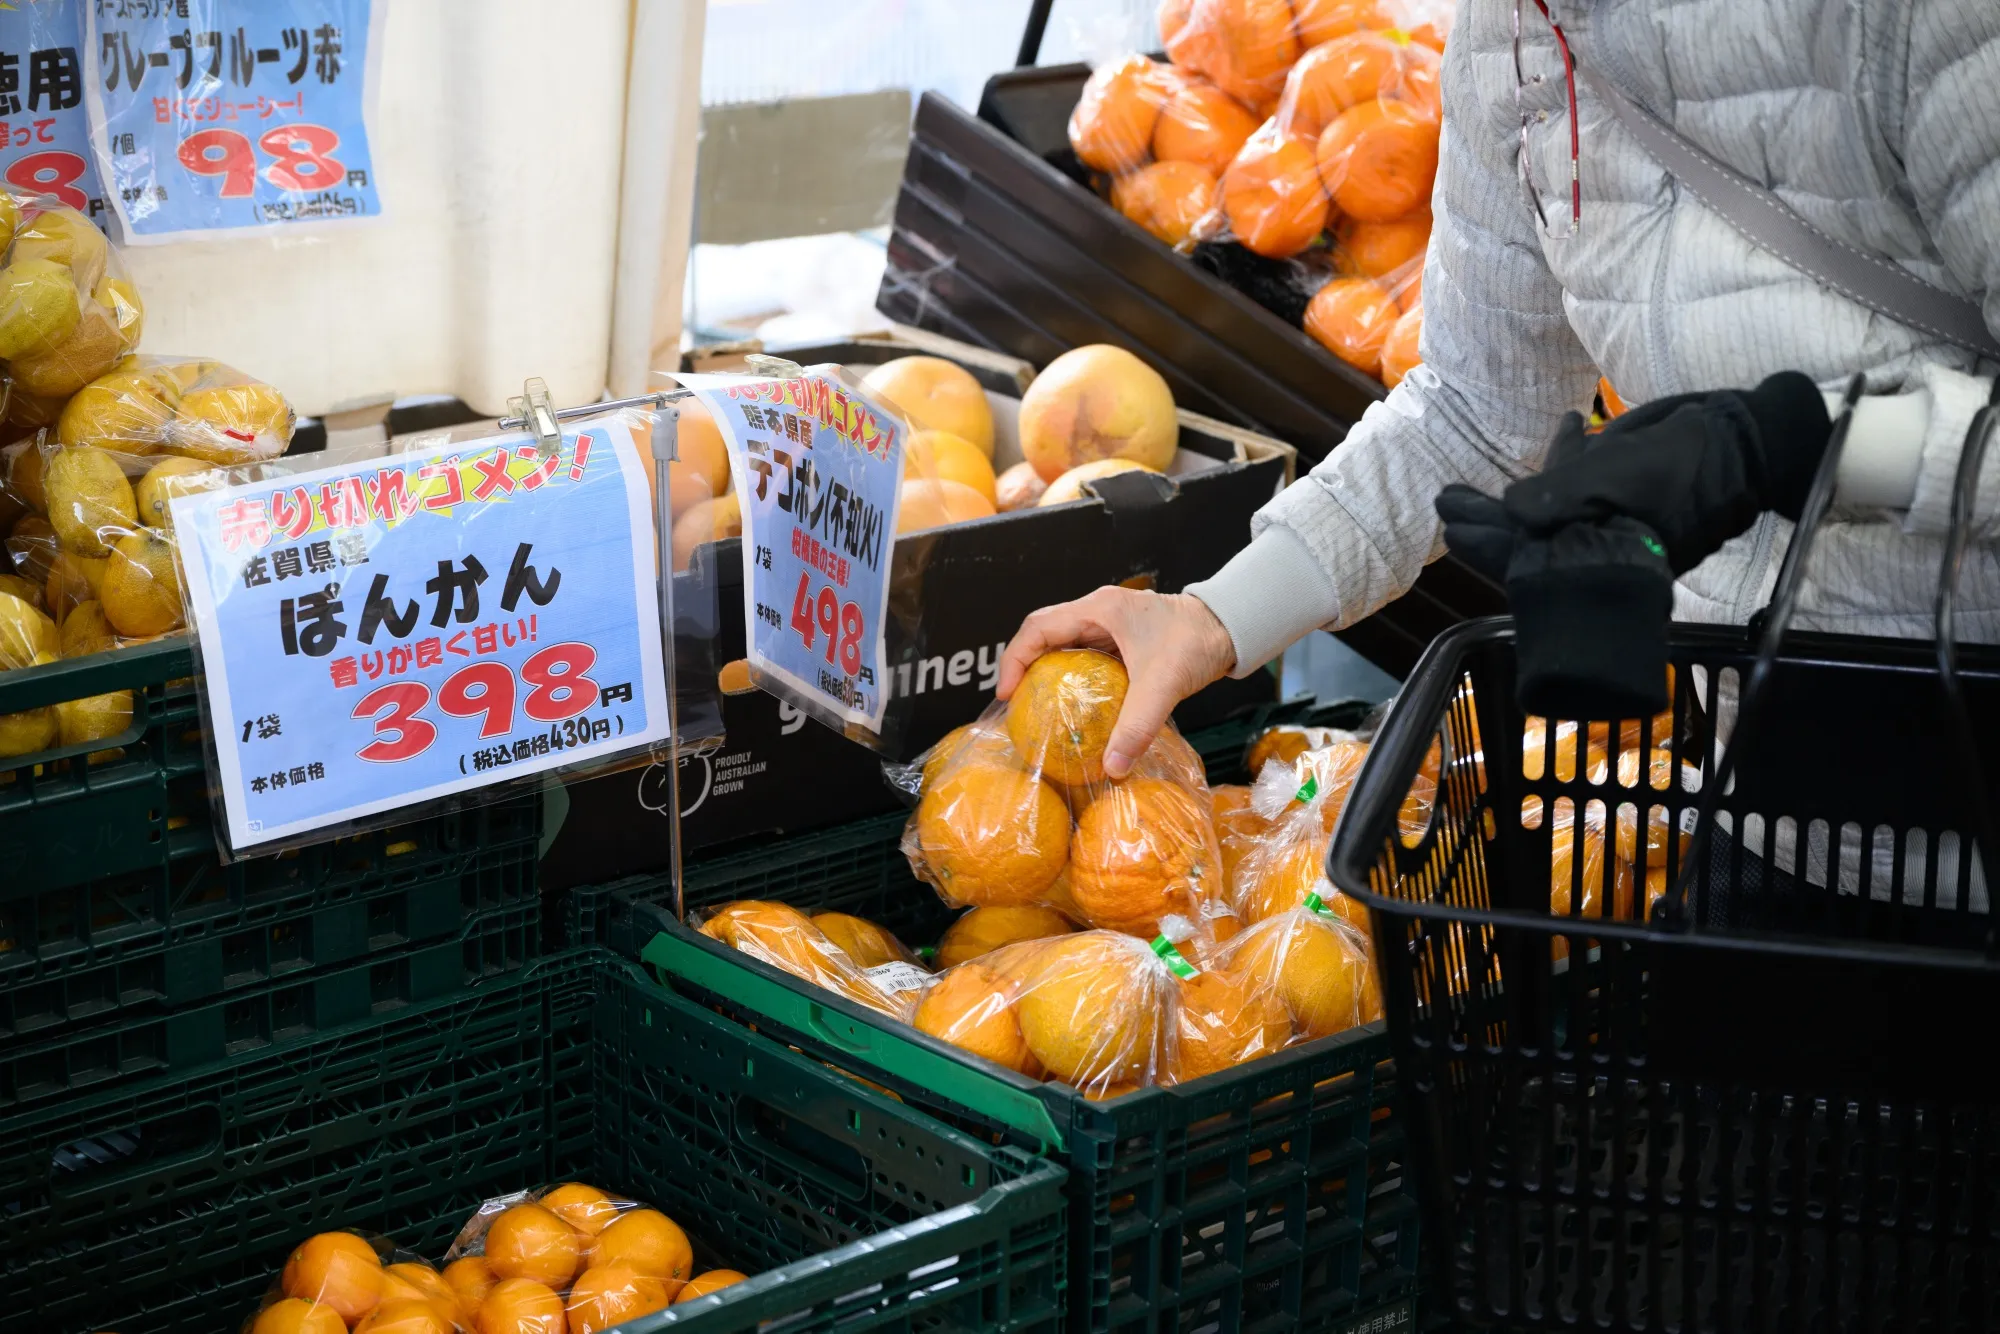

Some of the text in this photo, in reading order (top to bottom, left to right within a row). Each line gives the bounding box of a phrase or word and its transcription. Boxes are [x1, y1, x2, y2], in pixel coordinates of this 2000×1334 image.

[740, 403, 813, 450] 熊本県産
[240, 534, 370, 589] 佐賀県産
[755, 545, 772, 571] 1袋
[280, 542, 562, 657] ぽんかん
[329, 614, 538, 689] 香りが良く甘い!
[242, 713, 282, 743] 1袋
[715, 751, 742, 769] PROUDLY
[715, 761, 767, 783] AUSTRALIAN
[250, 761, 325, 794] 本体価格
[712, 780, 744, 796] GROWN
